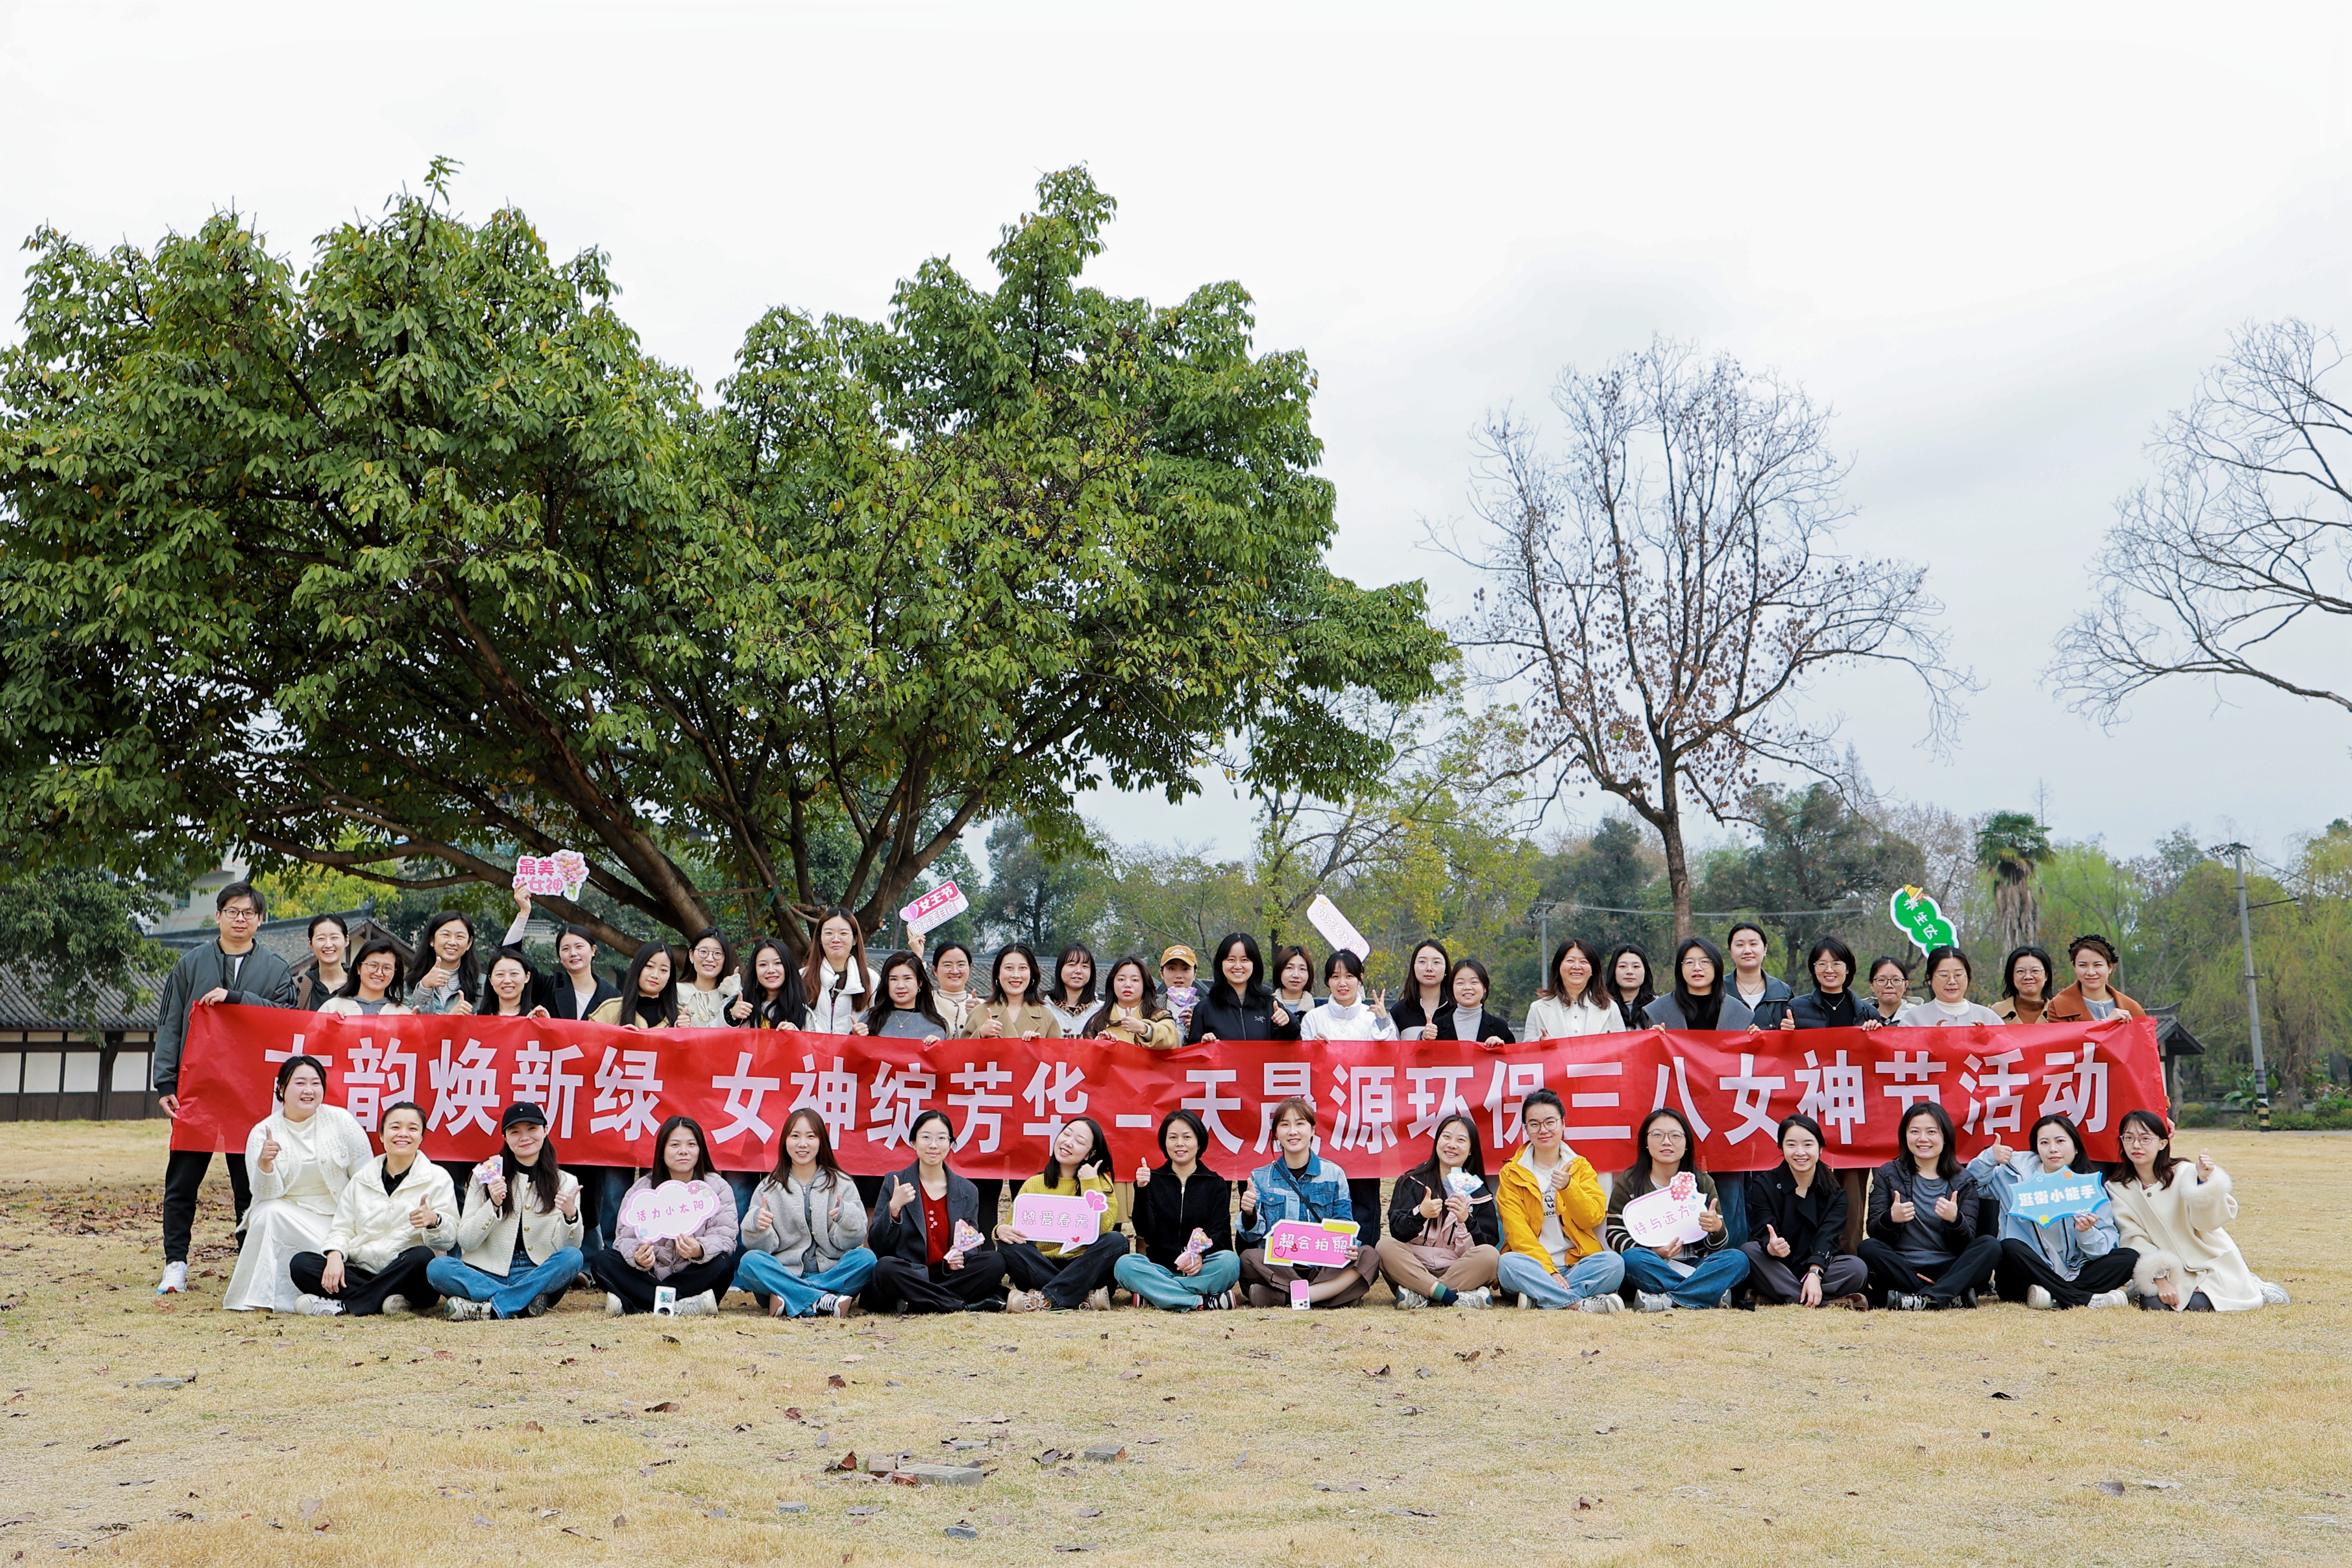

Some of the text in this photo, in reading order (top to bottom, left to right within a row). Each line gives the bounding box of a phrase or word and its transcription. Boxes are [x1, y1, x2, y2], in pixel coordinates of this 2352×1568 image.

[519, 858, 554, 876] 最美
[528, 876, 563, 893] 女神
[918, 885, 954, 913] 女王节
[912, 902, 957, 934] 做最美自己
[1316, 906, 1361, 954] 奶茶爱好者
[2018, 1184, 2096, 1207] 逛街小能手
[637, 1200, 704, 1221] 活力小太阳
[1022, 1210, 1089, 1228] 热爱春天
[1279, 1233, 1348, 1253] 超会拍照
